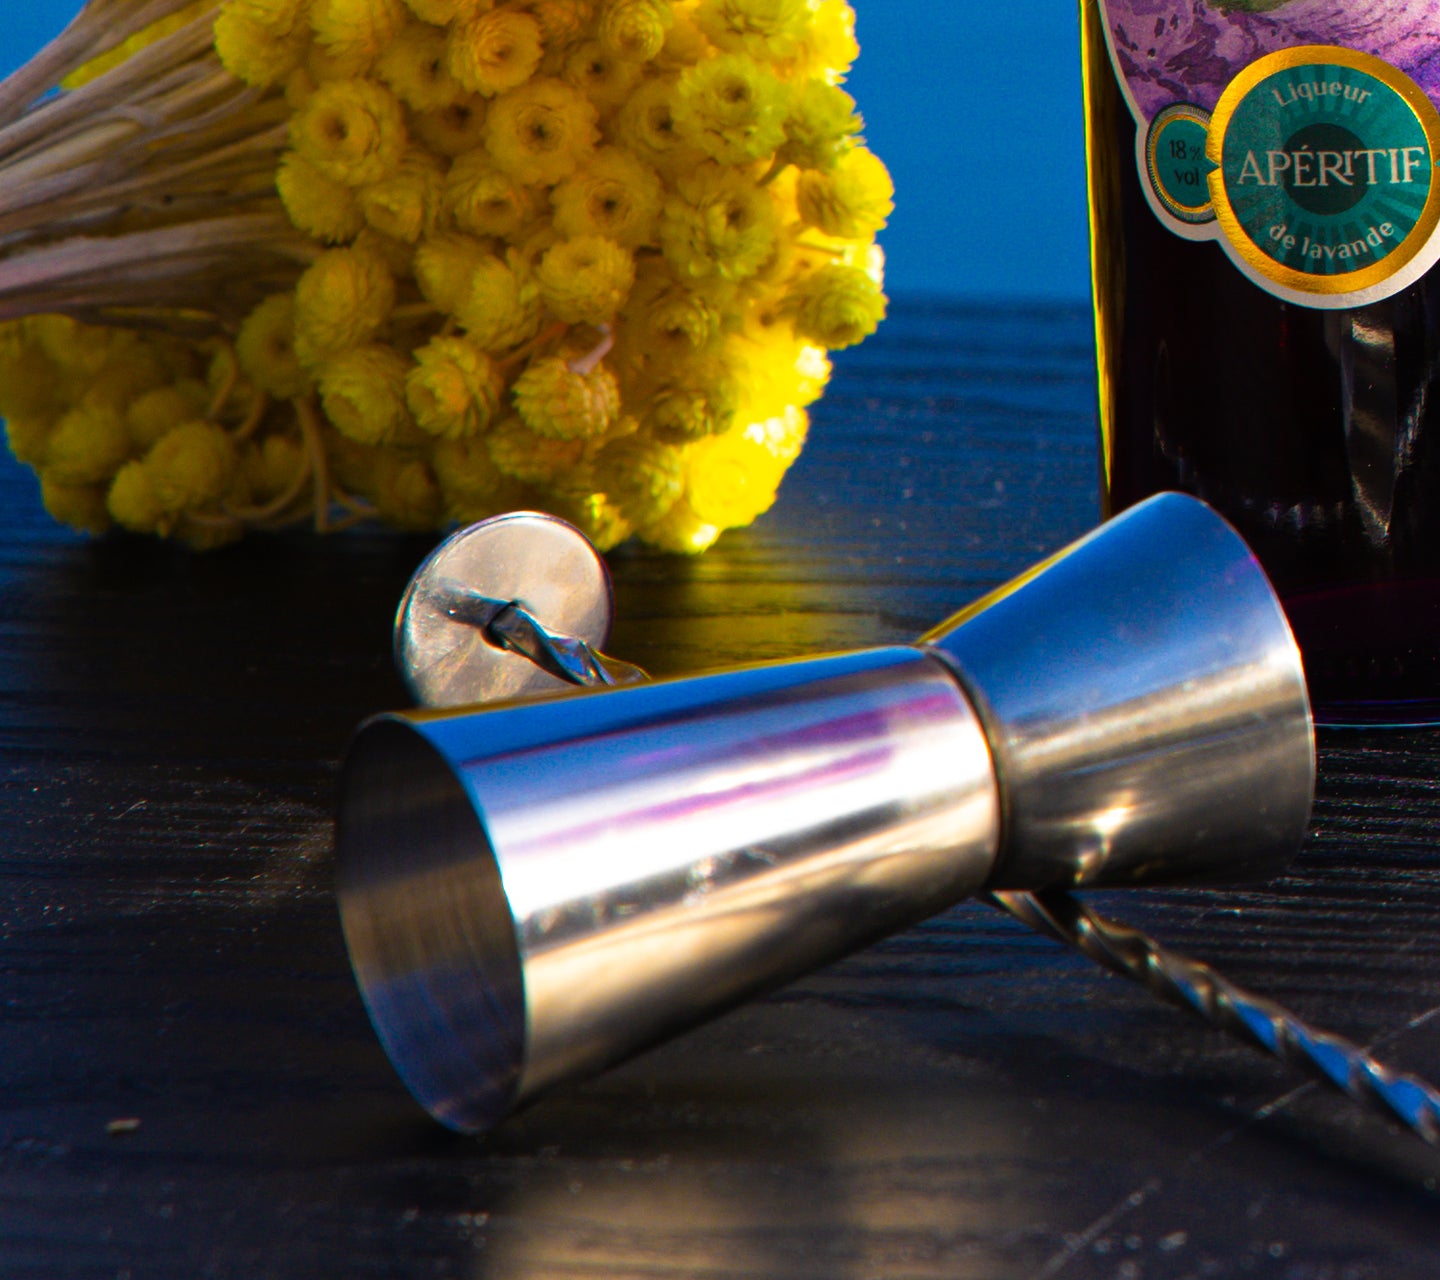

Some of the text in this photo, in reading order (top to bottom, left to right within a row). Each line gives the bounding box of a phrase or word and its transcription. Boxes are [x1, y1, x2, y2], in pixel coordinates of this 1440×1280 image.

[1271, 79, 1372, 108] Liqueur
[1173, 167, 1199, 186] vol
[1237, 145, 1425, 187] APÉRITIF
[1269, 220, 1395, 260] de lavande
